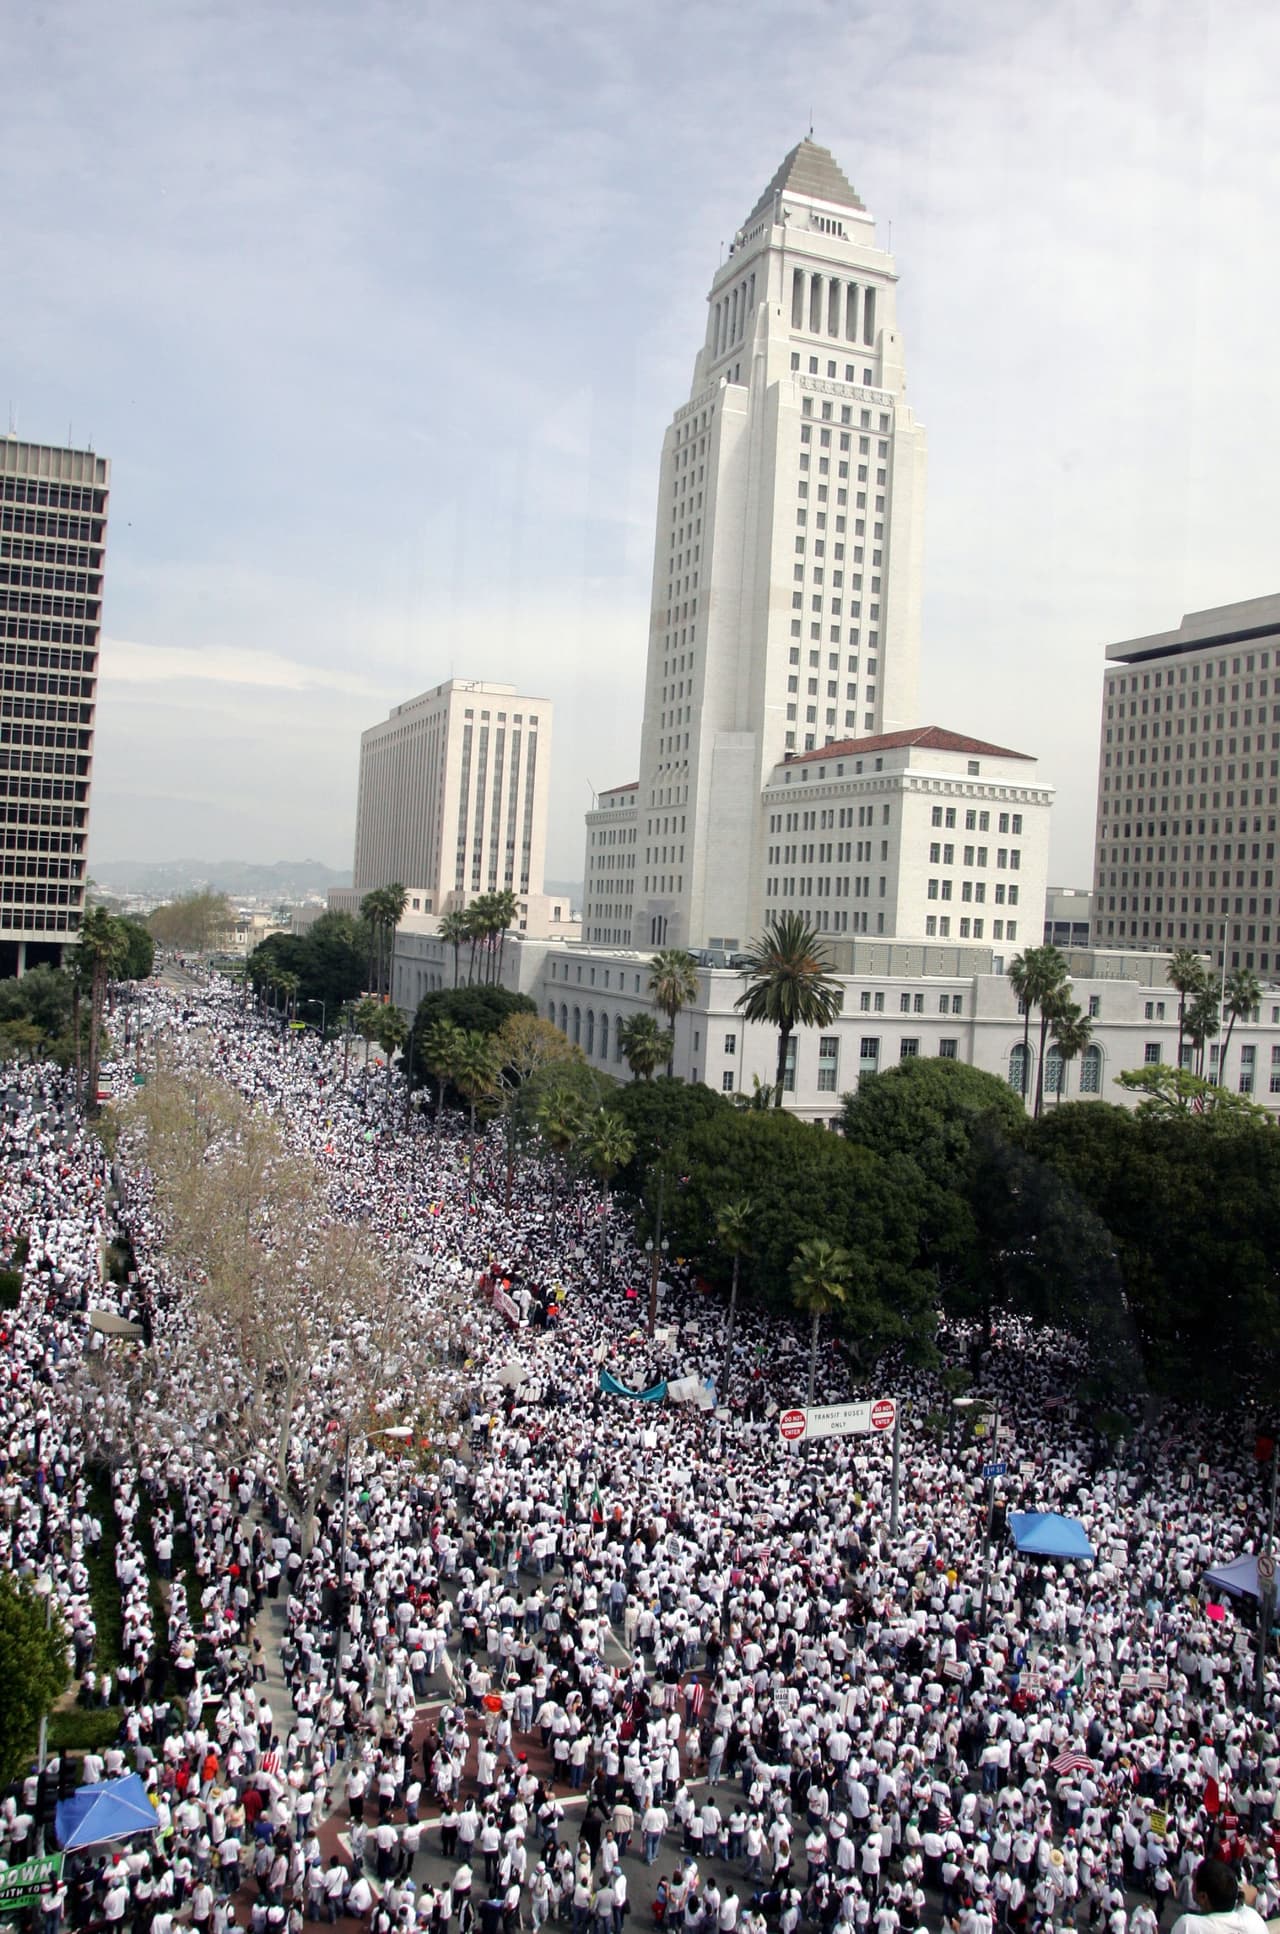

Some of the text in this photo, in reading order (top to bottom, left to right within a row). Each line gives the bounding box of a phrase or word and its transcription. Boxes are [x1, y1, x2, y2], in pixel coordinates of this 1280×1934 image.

[814, 1409, 864, 1420] TRANSIT BUSES
[831, 1421, 846, 1429] ONLY
[874, 1418, 890, 1426] ENTER
[784, 1428, 801, 1436] ENTER
